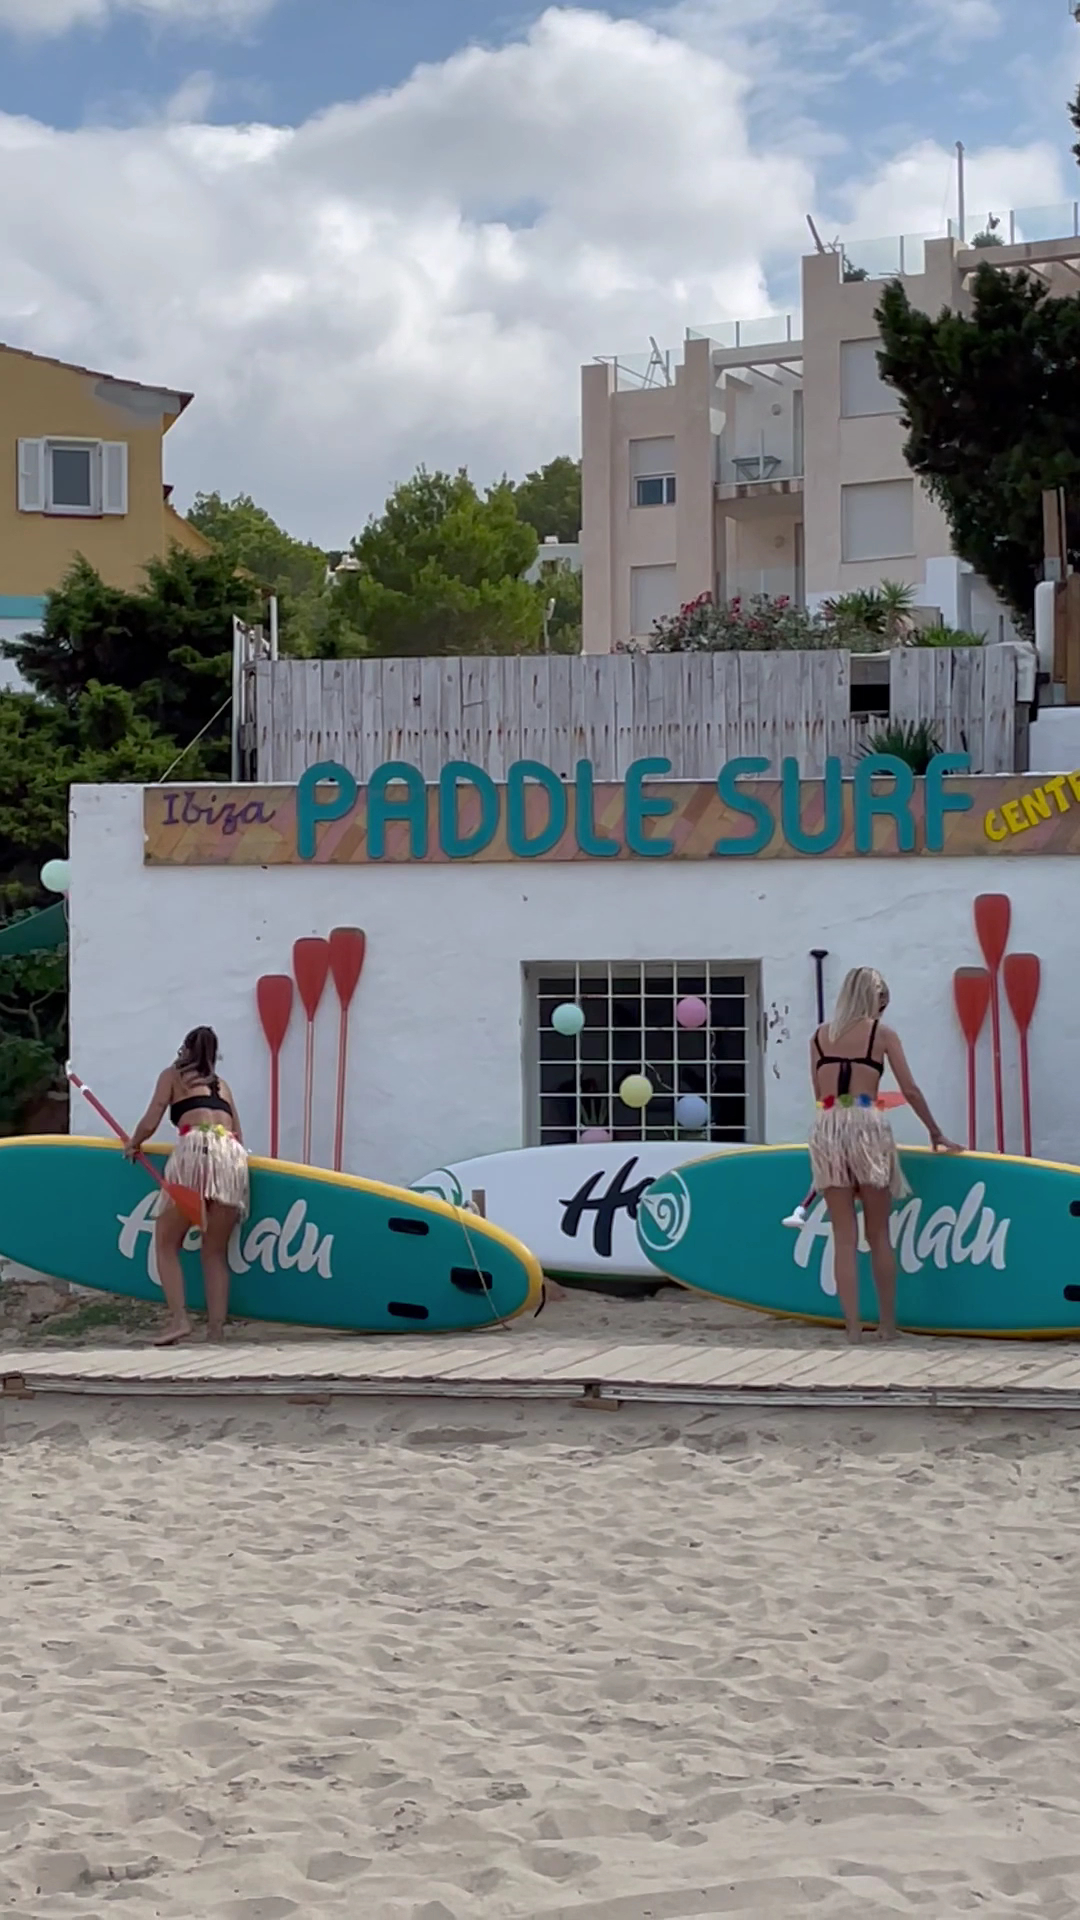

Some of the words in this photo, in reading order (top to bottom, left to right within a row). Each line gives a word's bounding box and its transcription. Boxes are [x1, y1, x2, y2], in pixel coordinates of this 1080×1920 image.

[162, 792, 277, 836] Ibiza
[296, 756, 676, 860] PADDLE
[714, 752, 975, 856] SURF
